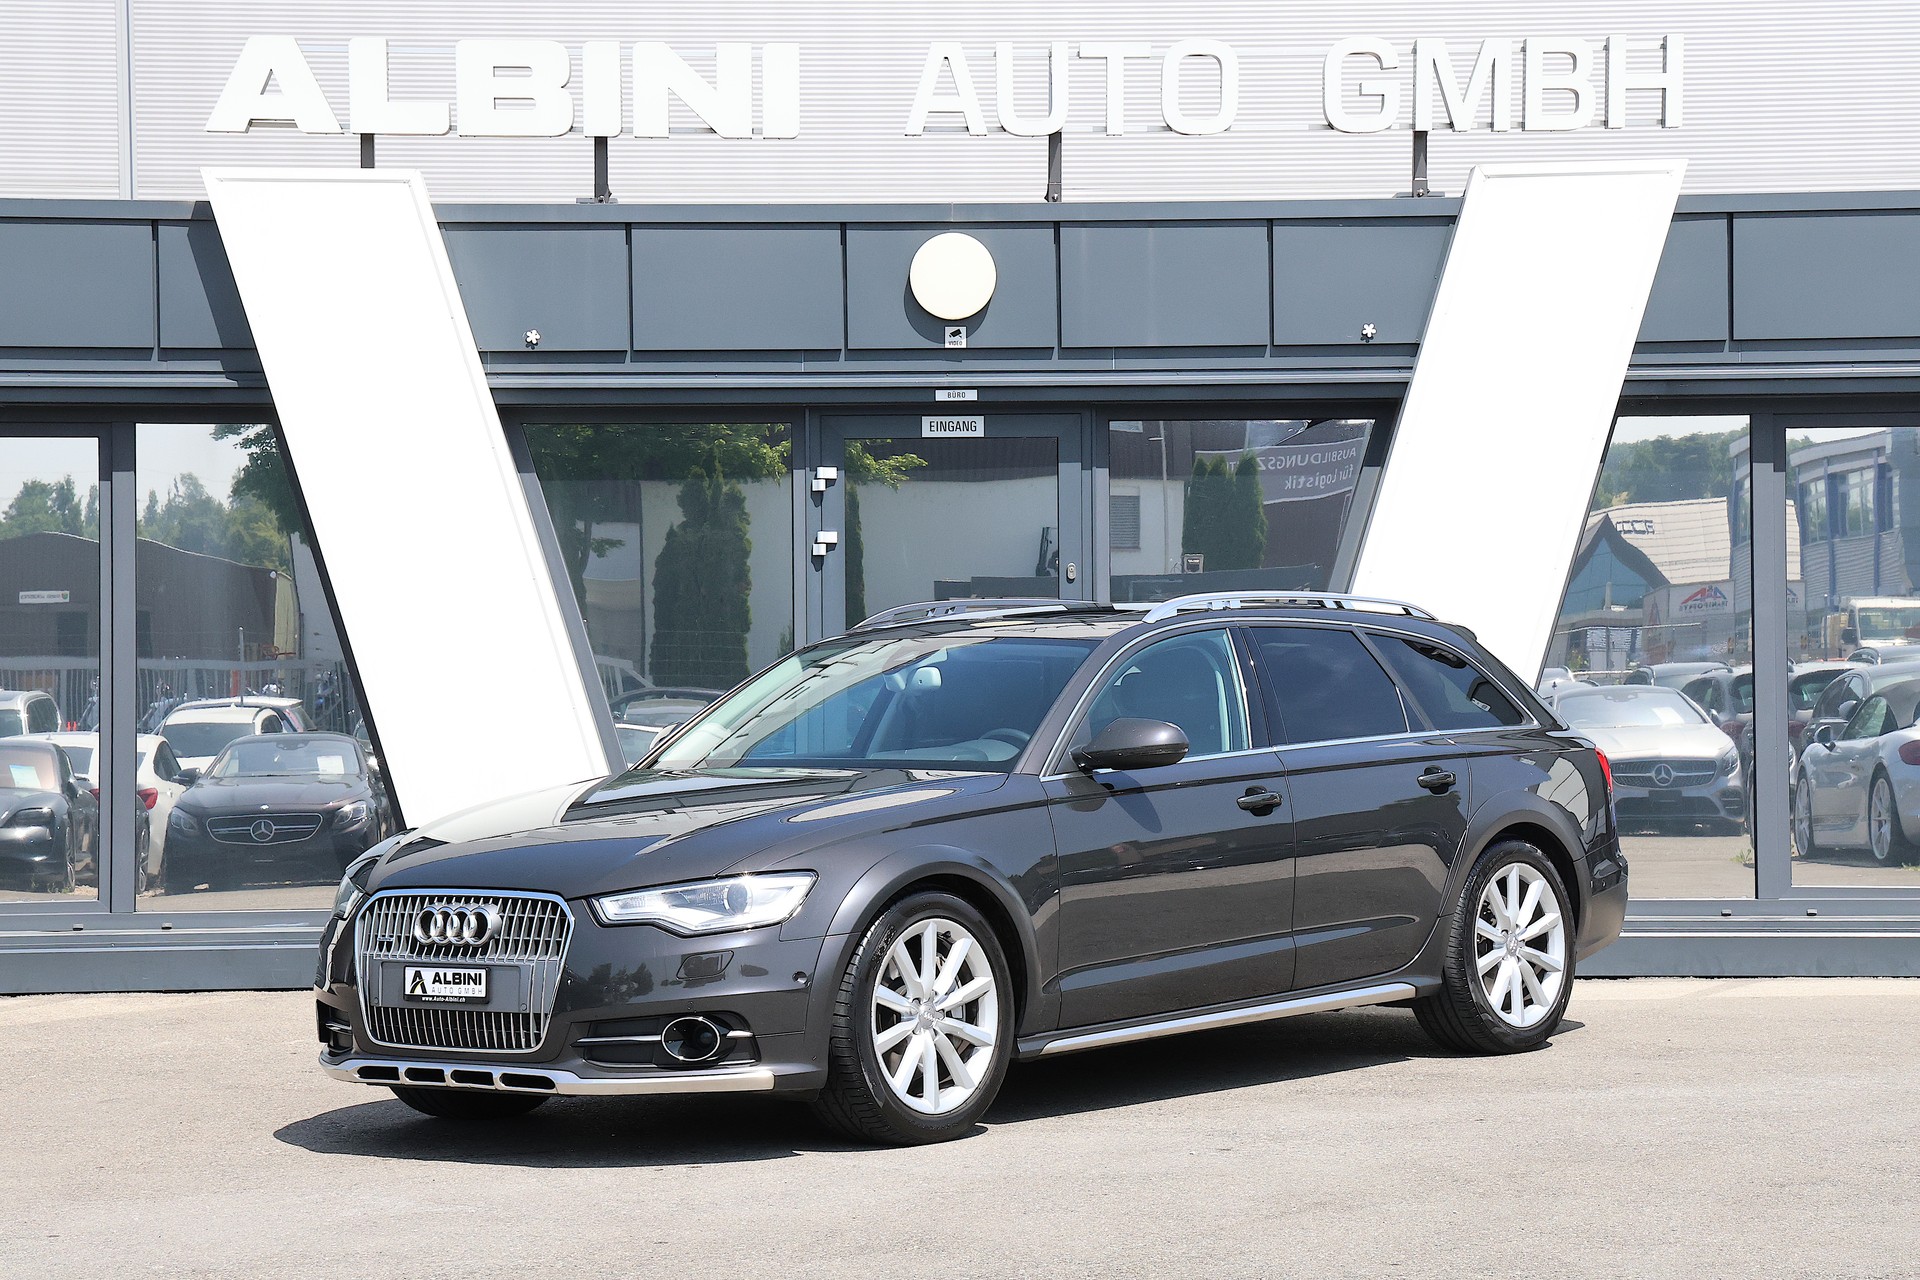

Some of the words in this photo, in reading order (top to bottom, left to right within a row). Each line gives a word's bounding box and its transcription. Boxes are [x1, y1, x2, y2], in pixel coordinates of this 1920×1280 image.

[203, 36, 801, 139] ALBINI
[903, 39, 1240, 137] AUTO
[1322, 33, 1685, 134] GMBH
[947, 391, 966, 399] BÜRO
[929, 420, 977, 432] EINGANG
[432, 972, 482, 986] ALBINI
[431, 986, 454, 994] AUTO
[458, 987, 483, 995] GMBH
